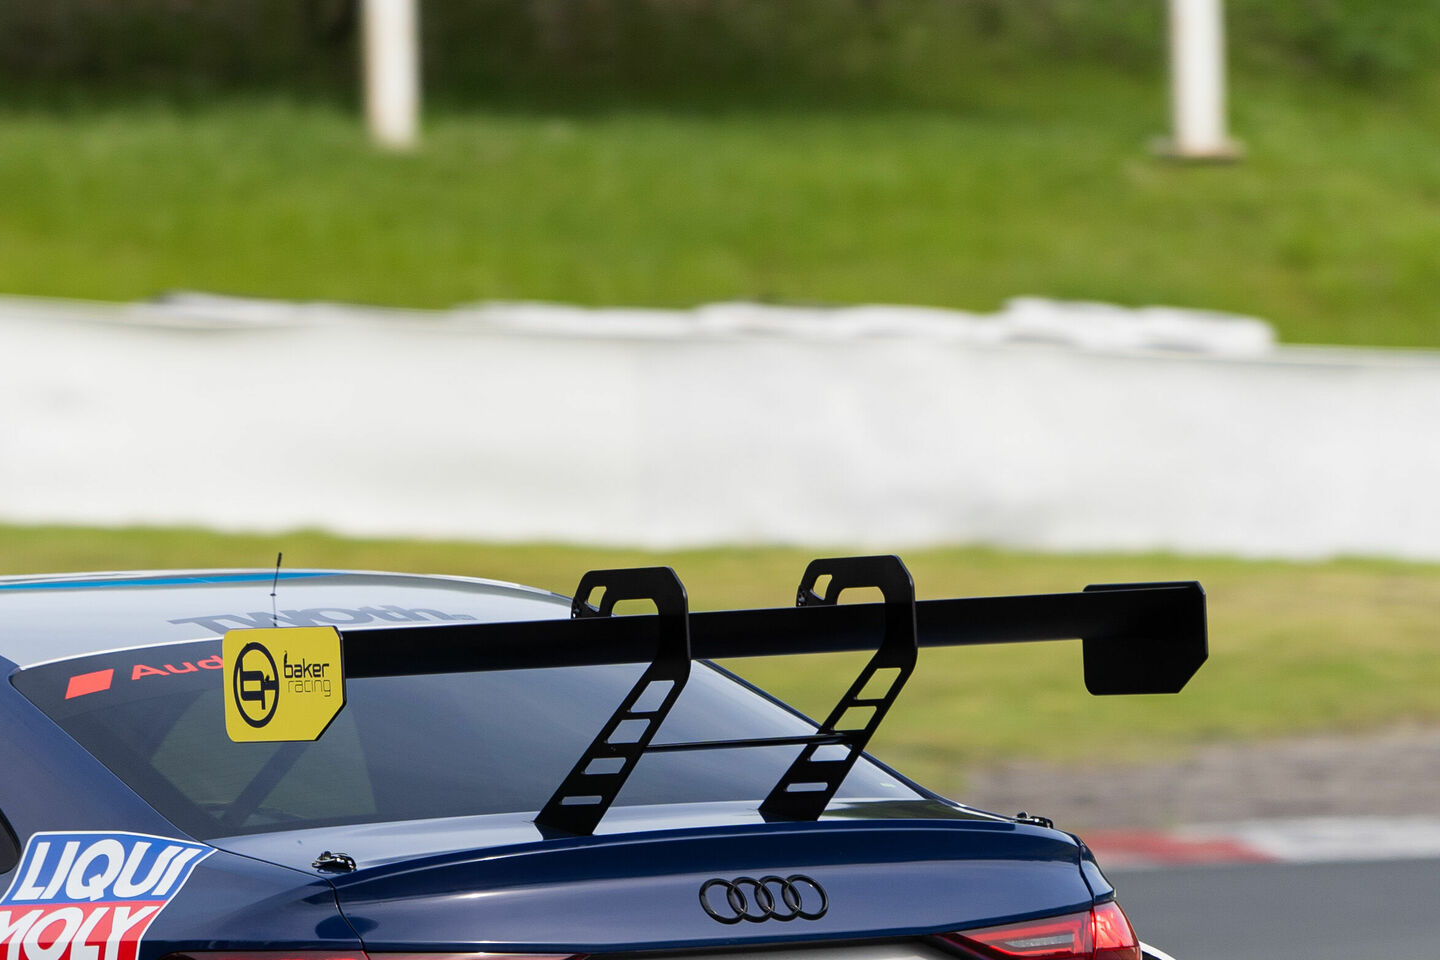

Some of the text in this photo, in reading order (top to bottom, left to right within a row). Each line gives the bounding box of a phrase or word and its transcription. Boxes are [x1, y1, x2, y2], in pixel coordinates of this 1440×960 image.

[131, 655, 224, 680] Aud
[283, 650, 329, 678] baker
[288, 679, 331, 697] racing
[11, 838, 204, 901] LIQUI
